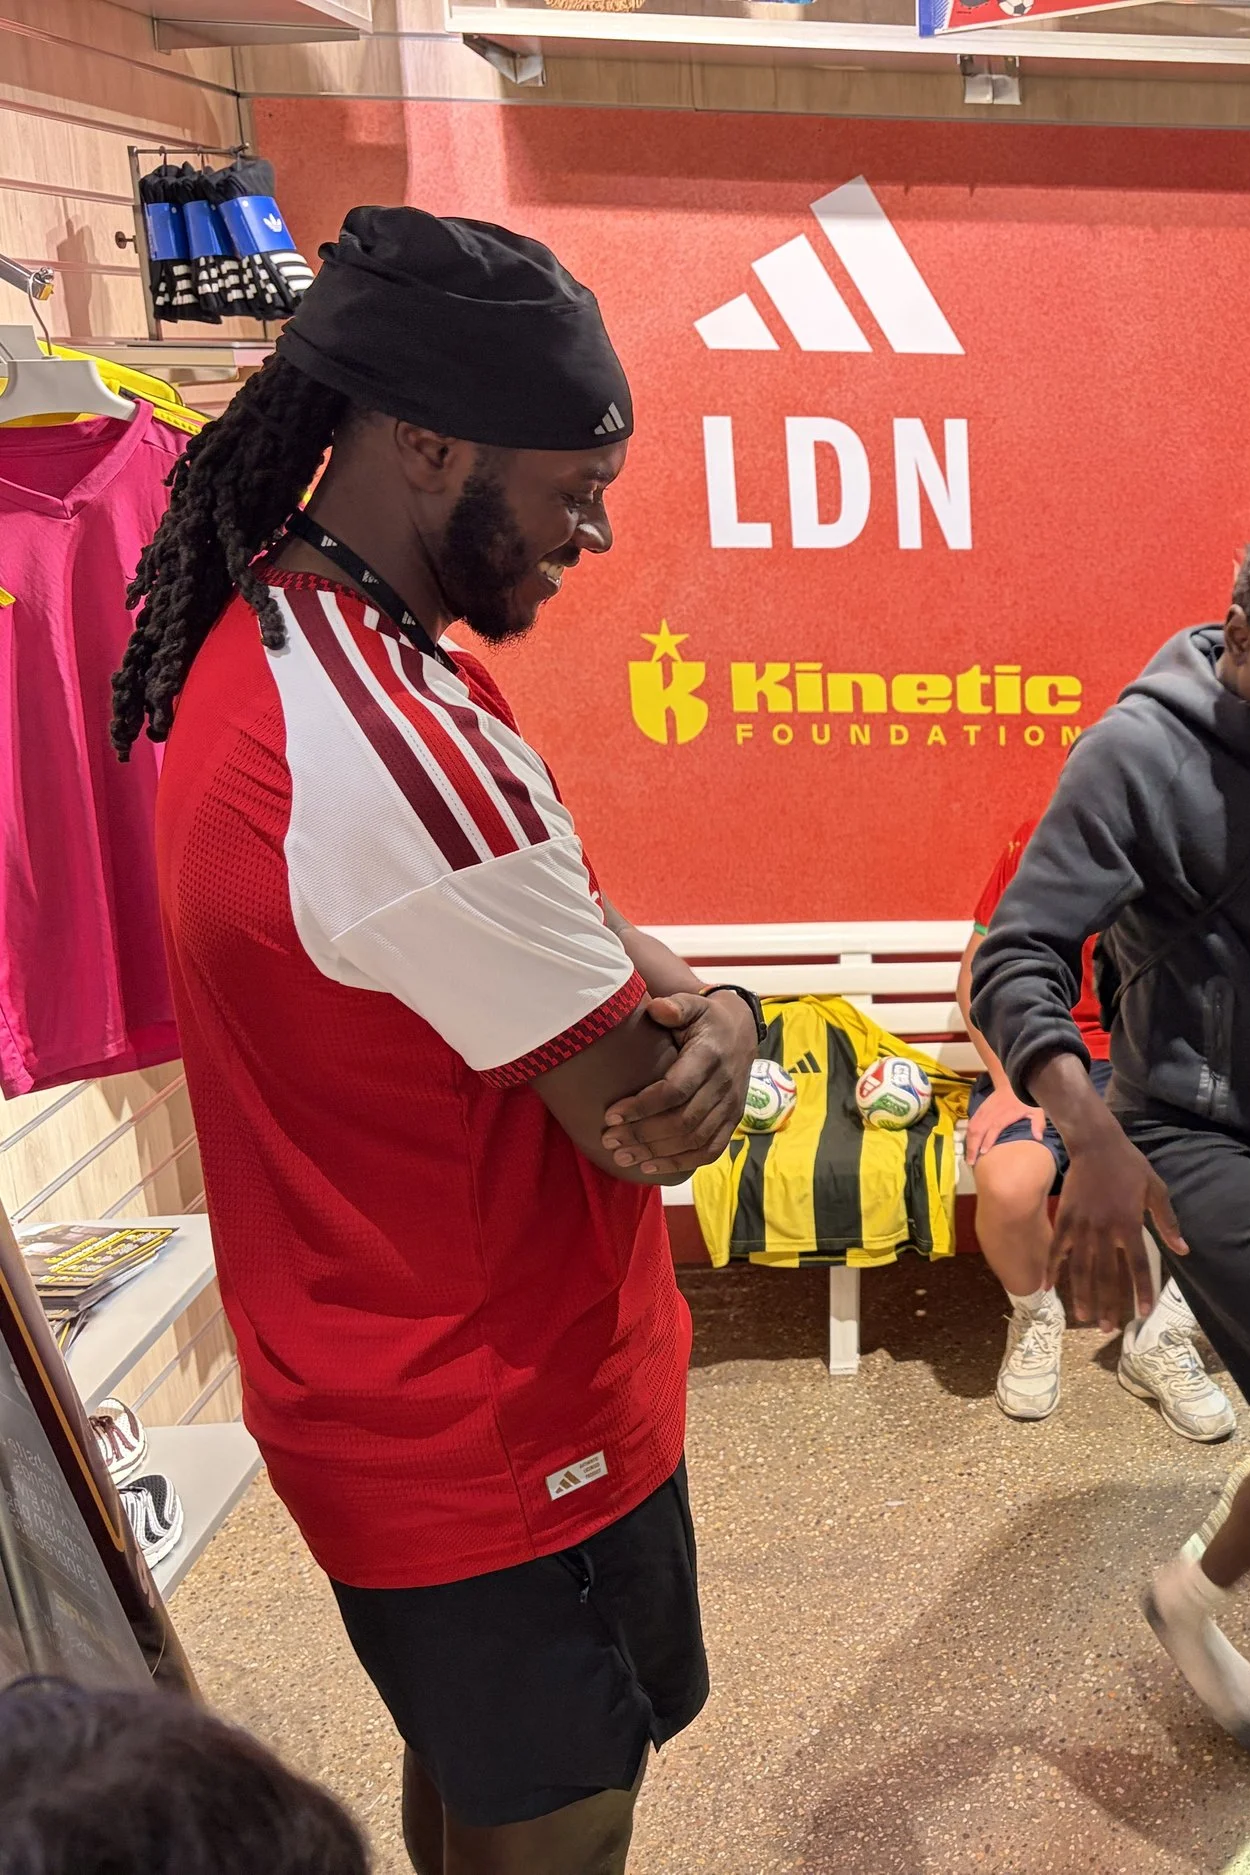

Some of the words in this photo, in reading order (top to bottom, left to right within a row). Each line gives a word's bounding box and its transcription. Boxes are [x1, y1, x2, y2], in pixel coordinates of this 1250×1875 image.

[702, 415, 973, 550] LDN
[731, 662, 1083, 715] Kinetic
[736, 723, 1083, 747] FOUNDATION
